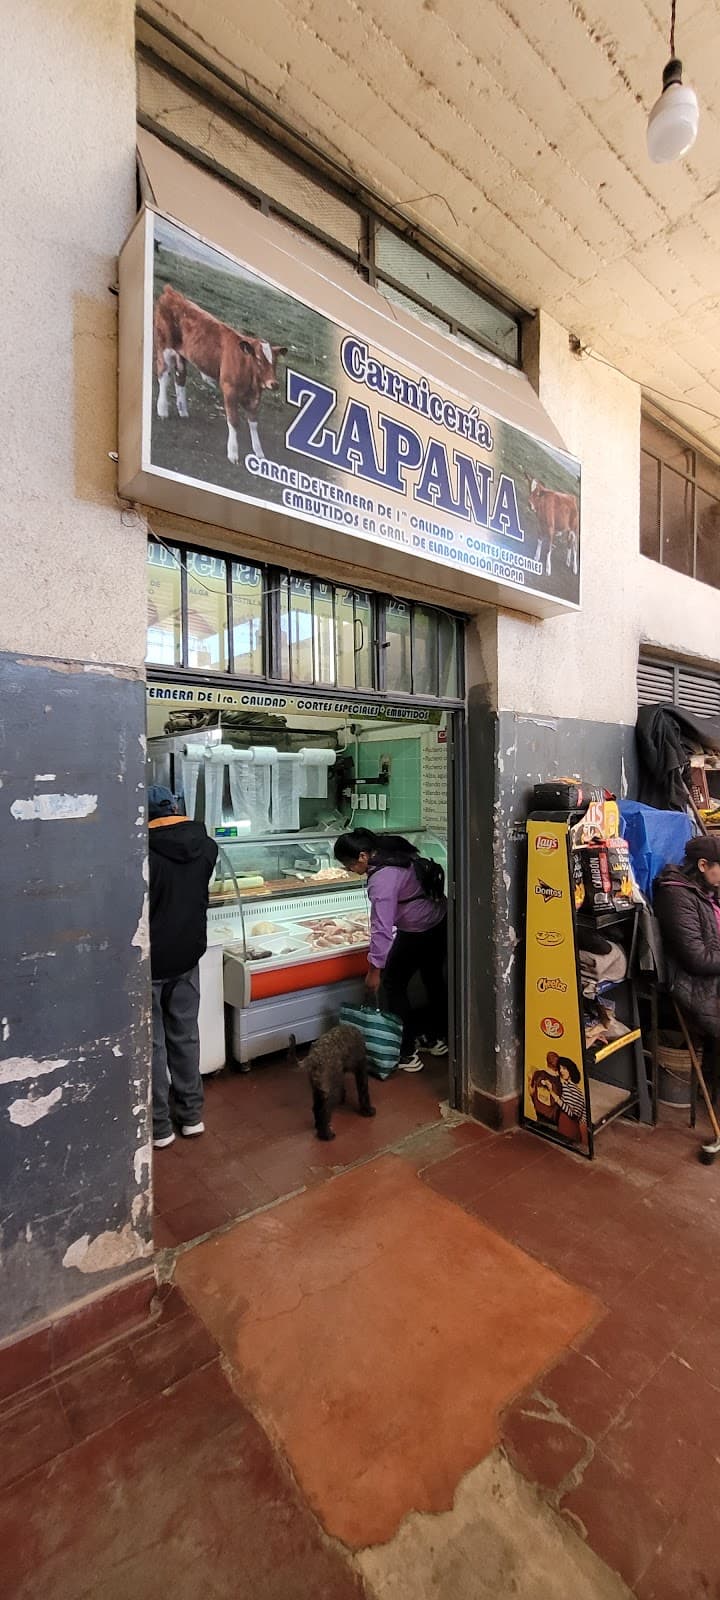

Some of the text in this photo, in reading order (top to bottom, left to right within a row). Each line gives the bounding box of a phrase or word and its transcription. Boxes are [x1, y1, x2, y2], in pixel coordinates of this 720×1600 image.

[341, 336, 494, 452] Carnicería
[286, 368, 524, 543] ZAPANA
[247, 457, 296, 486] CARNE
[300, 475, 319, 494] DE
[321, 484, 374, 513] TERNERA
[377, 503, 392, 519] DE
[410, 516, 454, 541] CALIDAD
[466, 537, 499, 558] CORTES
[501, 549, 543, 574] ESPECIALES
[284, 491, 524, 583] EMBUTIDOS EN GRAL. DE ELABORACIÓN PROPIA
[197, 691, 213, 702] DE
[241, 695, 287, 708] CALIDAD
[297, 700, 333, 712] CORTES
[335, 703, 379, 716] ESPECIALES
[386, 707, 428, 720] EMBUTIDOS
[535, 885, 563, 898] Doritos
[537, 977, 568, 993] Cheetos
